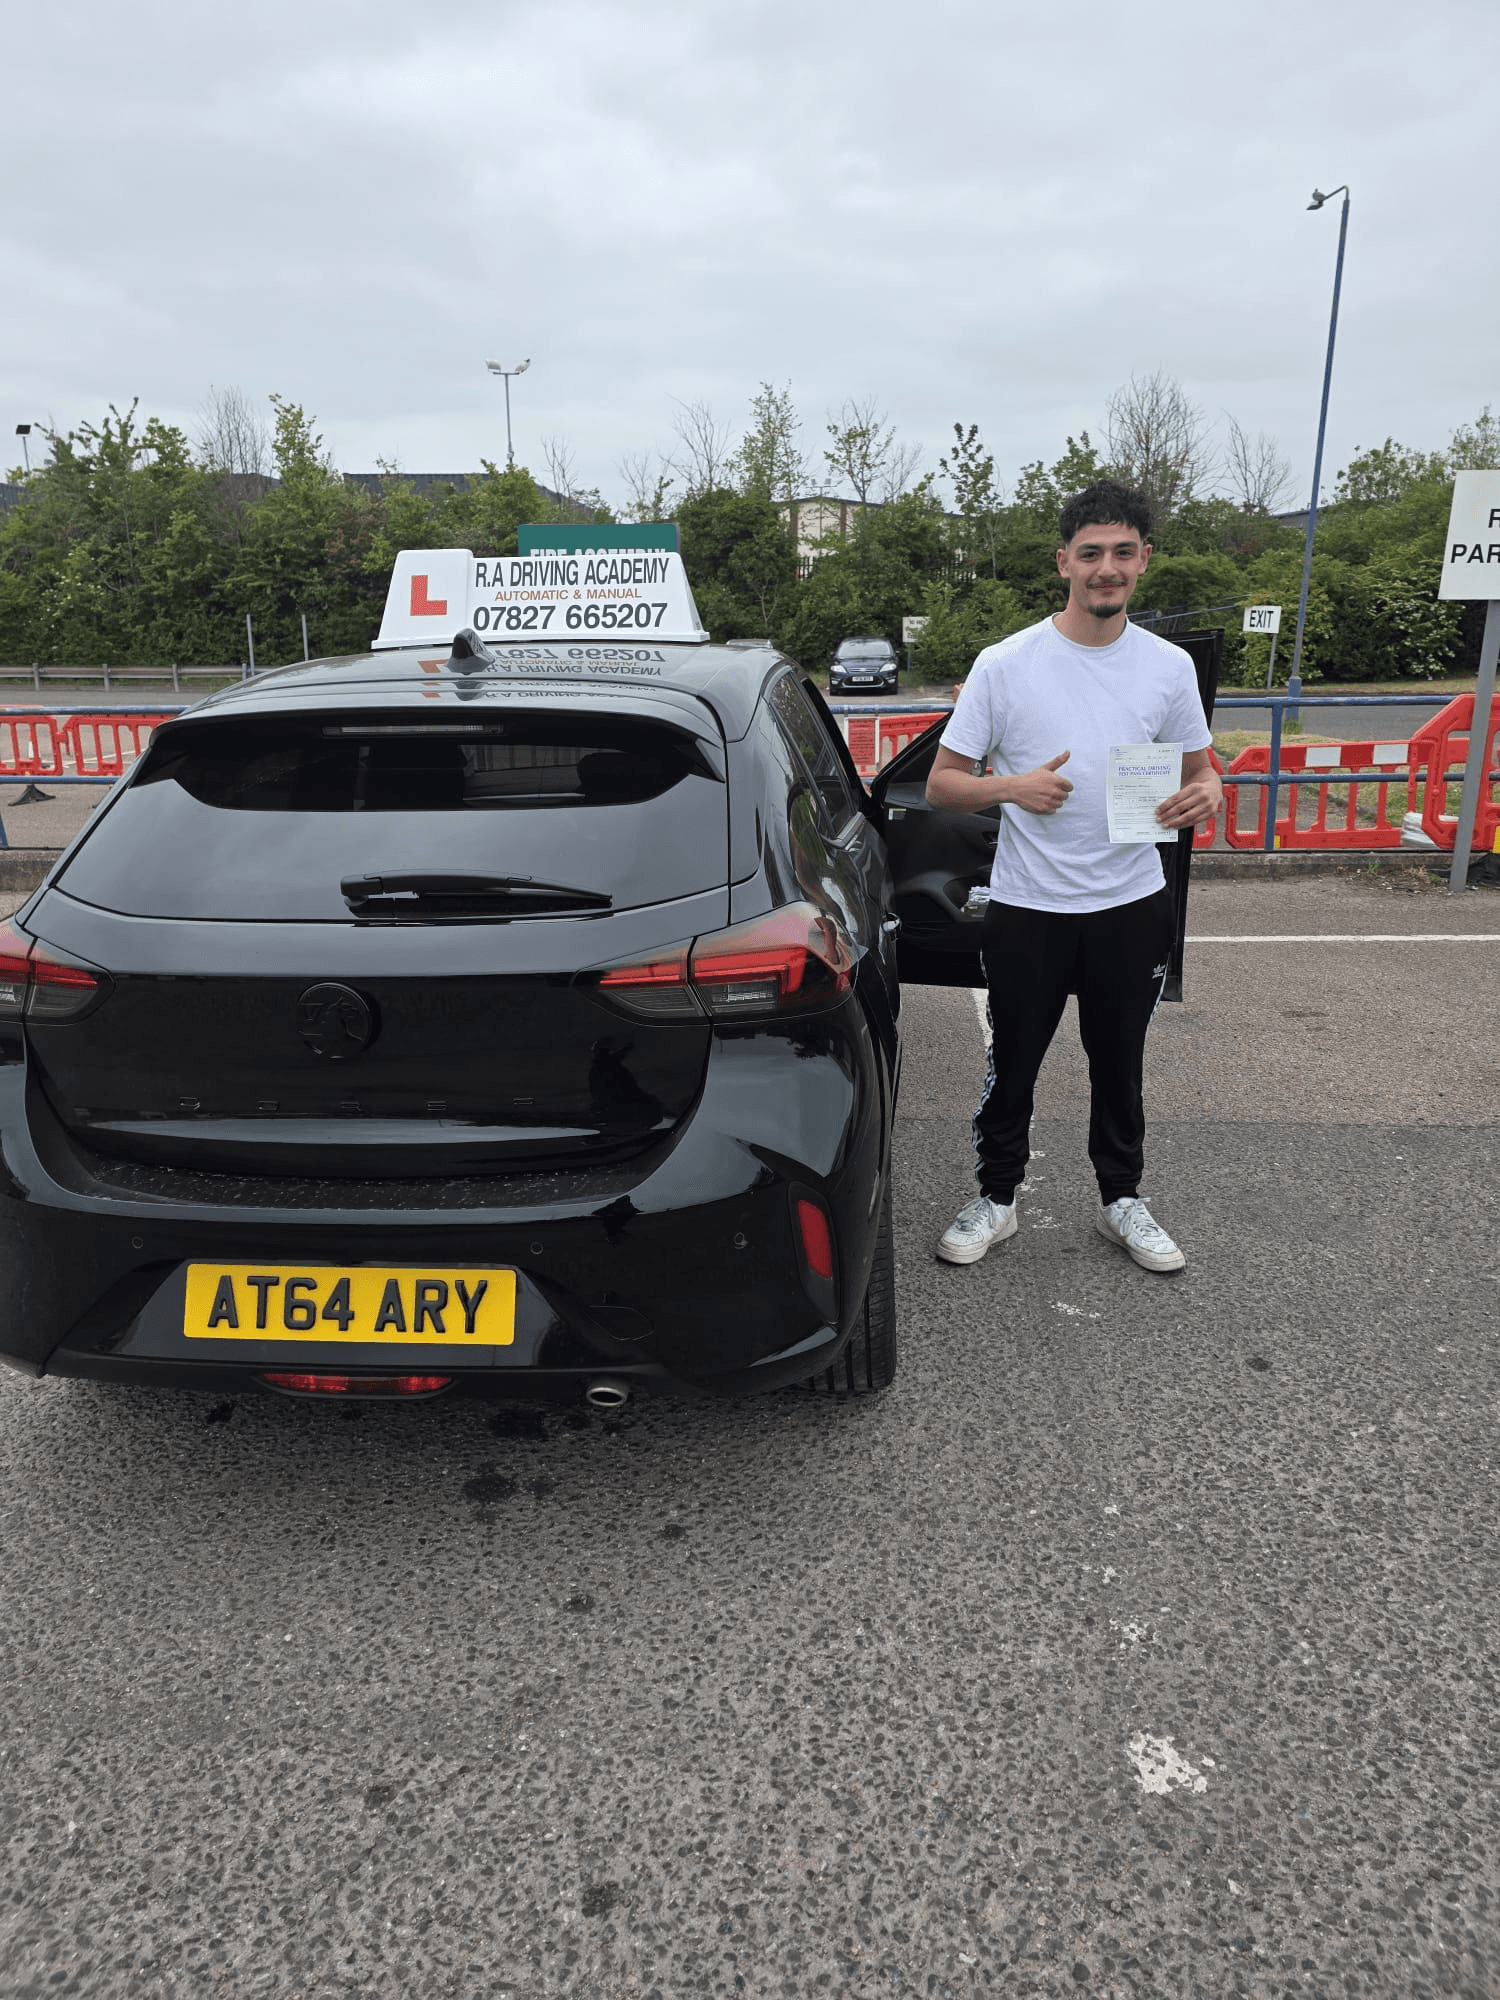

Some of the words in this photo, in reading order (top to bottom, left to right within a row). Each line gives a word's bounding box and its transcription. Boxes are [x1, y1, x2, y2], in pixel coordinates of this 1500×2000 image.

[475, 561, 504, 588] R.A
[510, 559, 579, 587] DRIVING
[584, 557, 670, 585] ACADEMY
[410, 575, 447, 616] L
[494, 589, 569, 602] AUTOMATIC
[573, 589, 582, 599] &
[586, 587, 643, 600] MANUAL
[473, 605, 556, 631] 07827
[565, 602, 668, 630] 665207
[1249, 609, 1275, 629] EXIT
[207, 1274, 355, 1332] AT64
[373, 1278, 489, 1334] ARY
